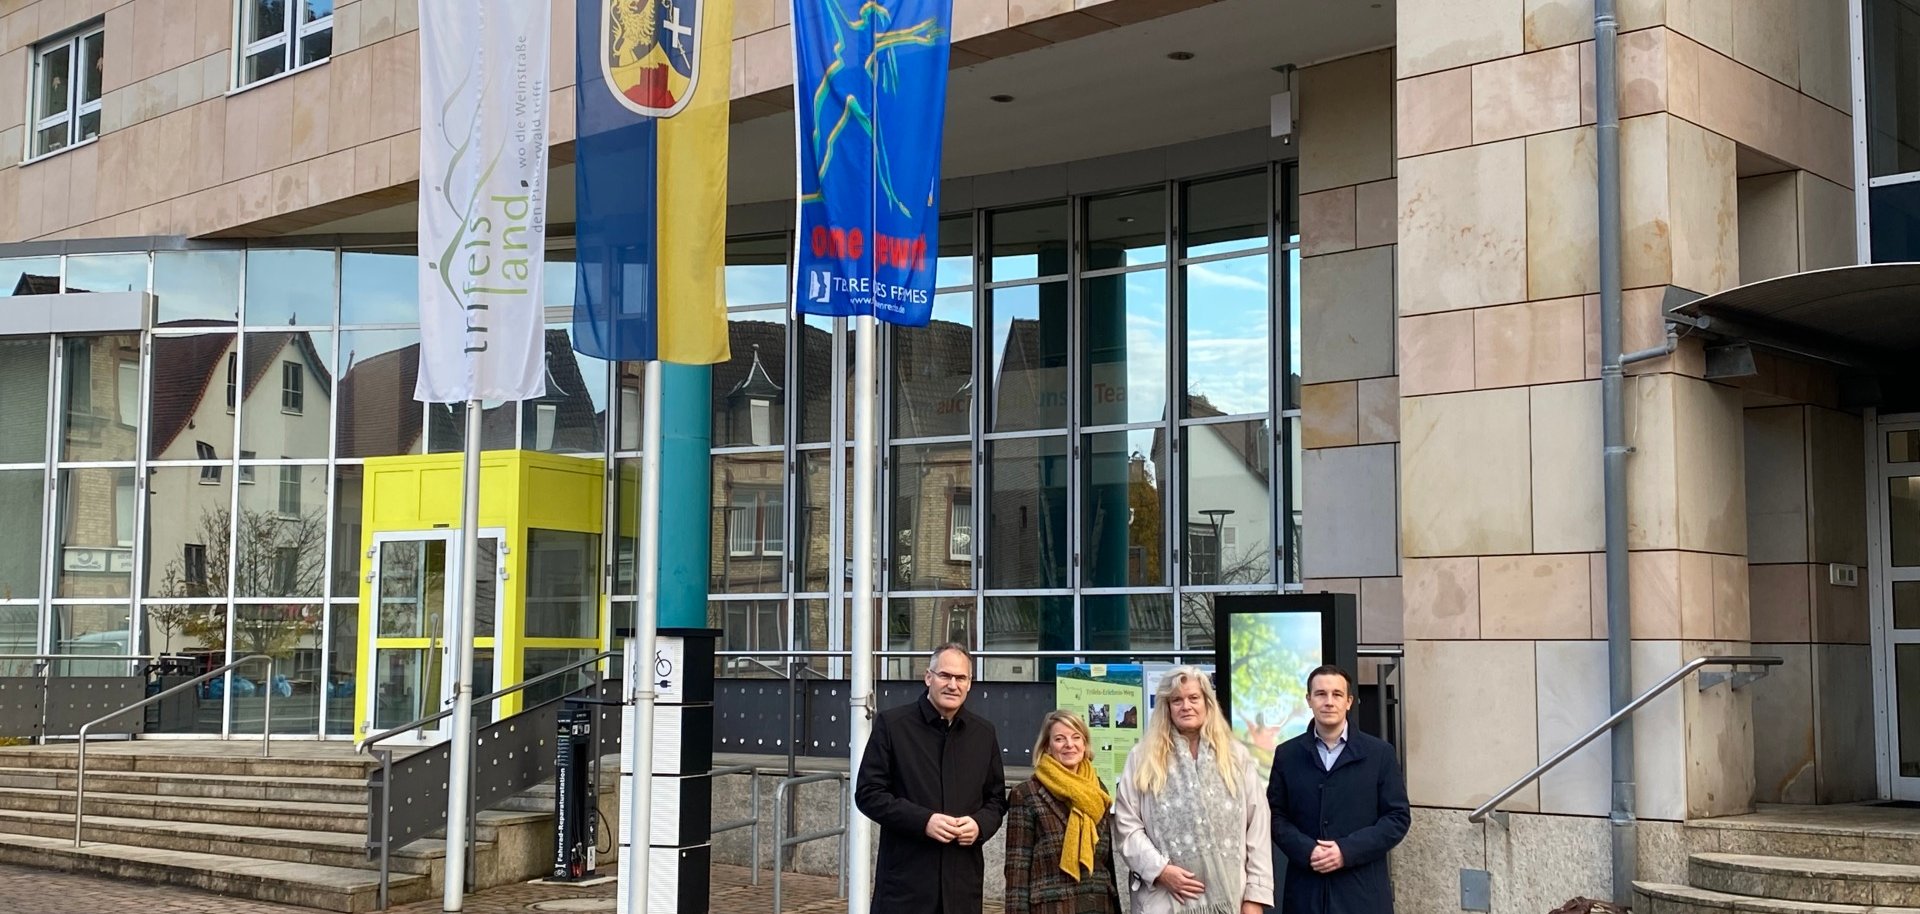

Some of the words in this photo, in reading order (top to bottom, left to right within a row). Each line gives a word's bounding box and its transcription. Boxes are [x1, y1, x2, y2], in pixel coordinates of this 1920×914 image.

[515, 35, 527, 117] Weinstraße
[516, 121, 526, 142] die
[519, 148, 527, 169] wo
[532, 207, 543, 233] den
[463, 216, 492, 358] trifels
[890, 285, 928, 304] FEMES
[557, 768, 566, 862] Fahrrad-Reparaturstation
